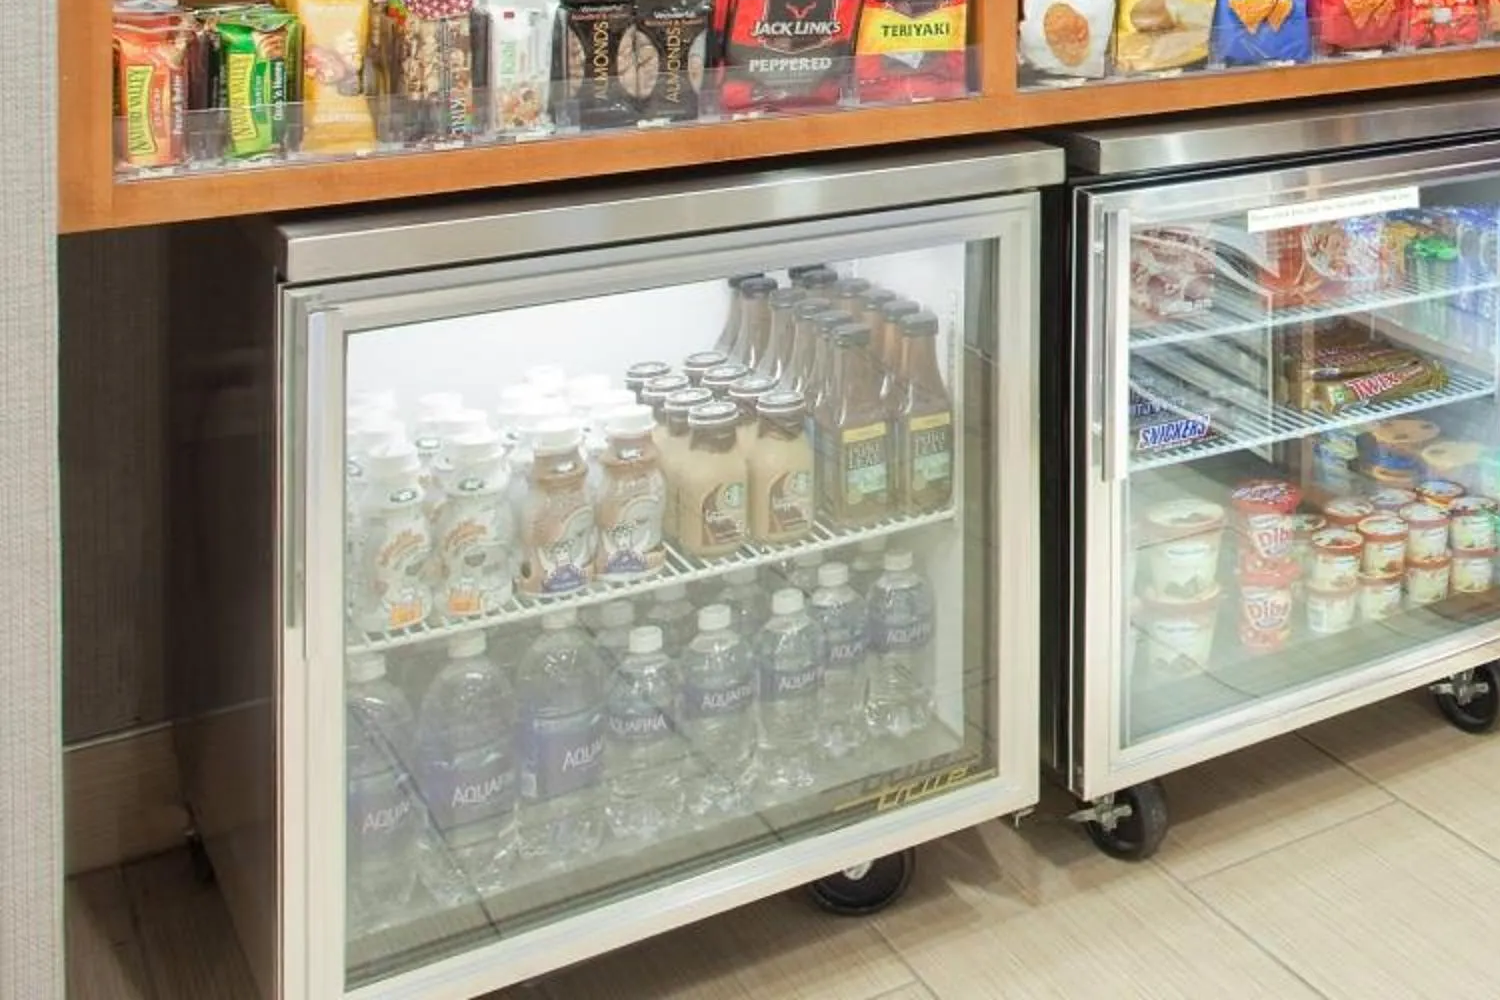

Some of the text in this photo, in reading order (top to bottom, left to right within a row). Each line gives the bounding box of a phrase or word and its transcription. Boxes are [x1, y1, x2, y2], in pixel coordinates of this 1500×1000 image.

[751, 19, 792, 37] JACK
[880, 21, 951, 39] TERIYAKI
[594, 20, 609, 99] ALMONDS
[666, 21, 682, 103] ALMONDS
[749, 56, 833, 74] PEPPERED
[1139, 416, 1211, 445] SNICKERS
